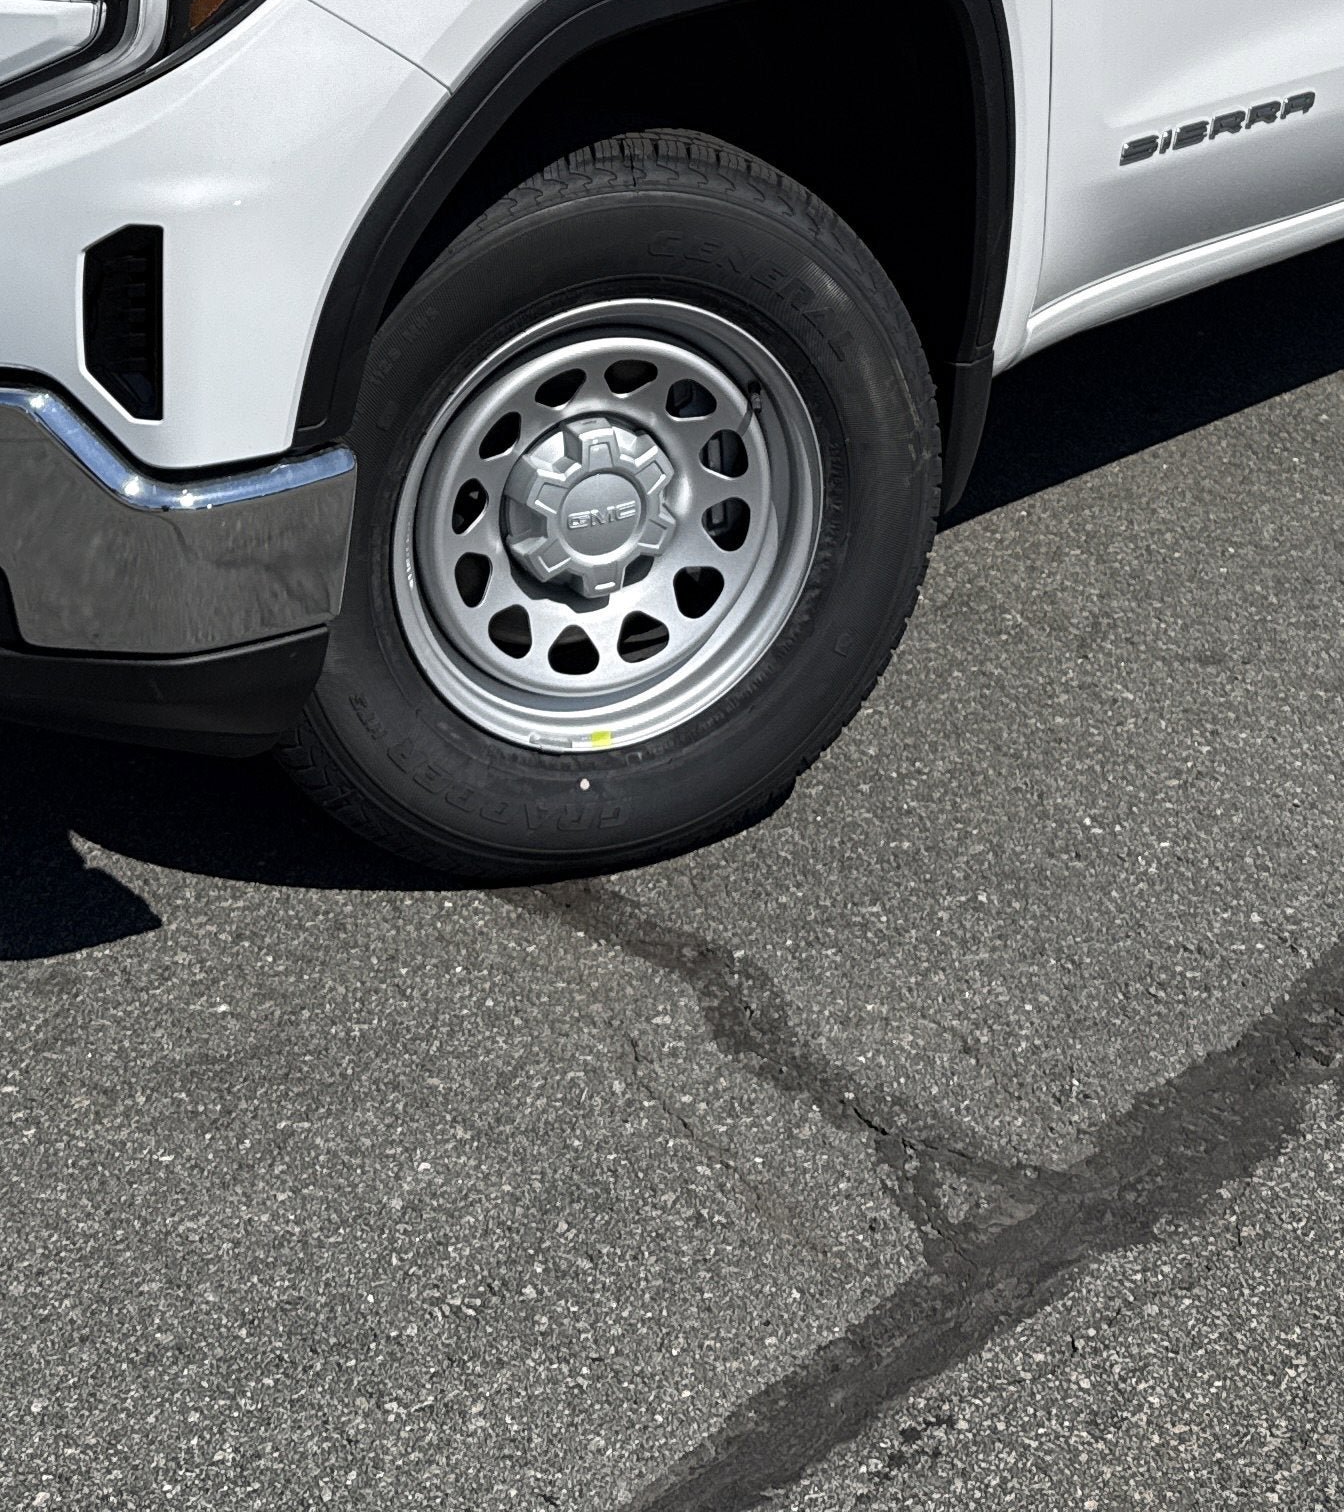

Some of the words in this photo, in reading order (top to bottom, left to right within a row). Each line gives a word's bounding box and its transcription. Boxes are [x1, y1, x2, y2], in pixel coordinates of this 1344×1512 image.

[1119, 90, 1316, 167] SIERRA
[647, 229, 855, 363] GENERAL
[567, 500, 637, 530] GMC
[386, 736, 634, 833] GRABBER
